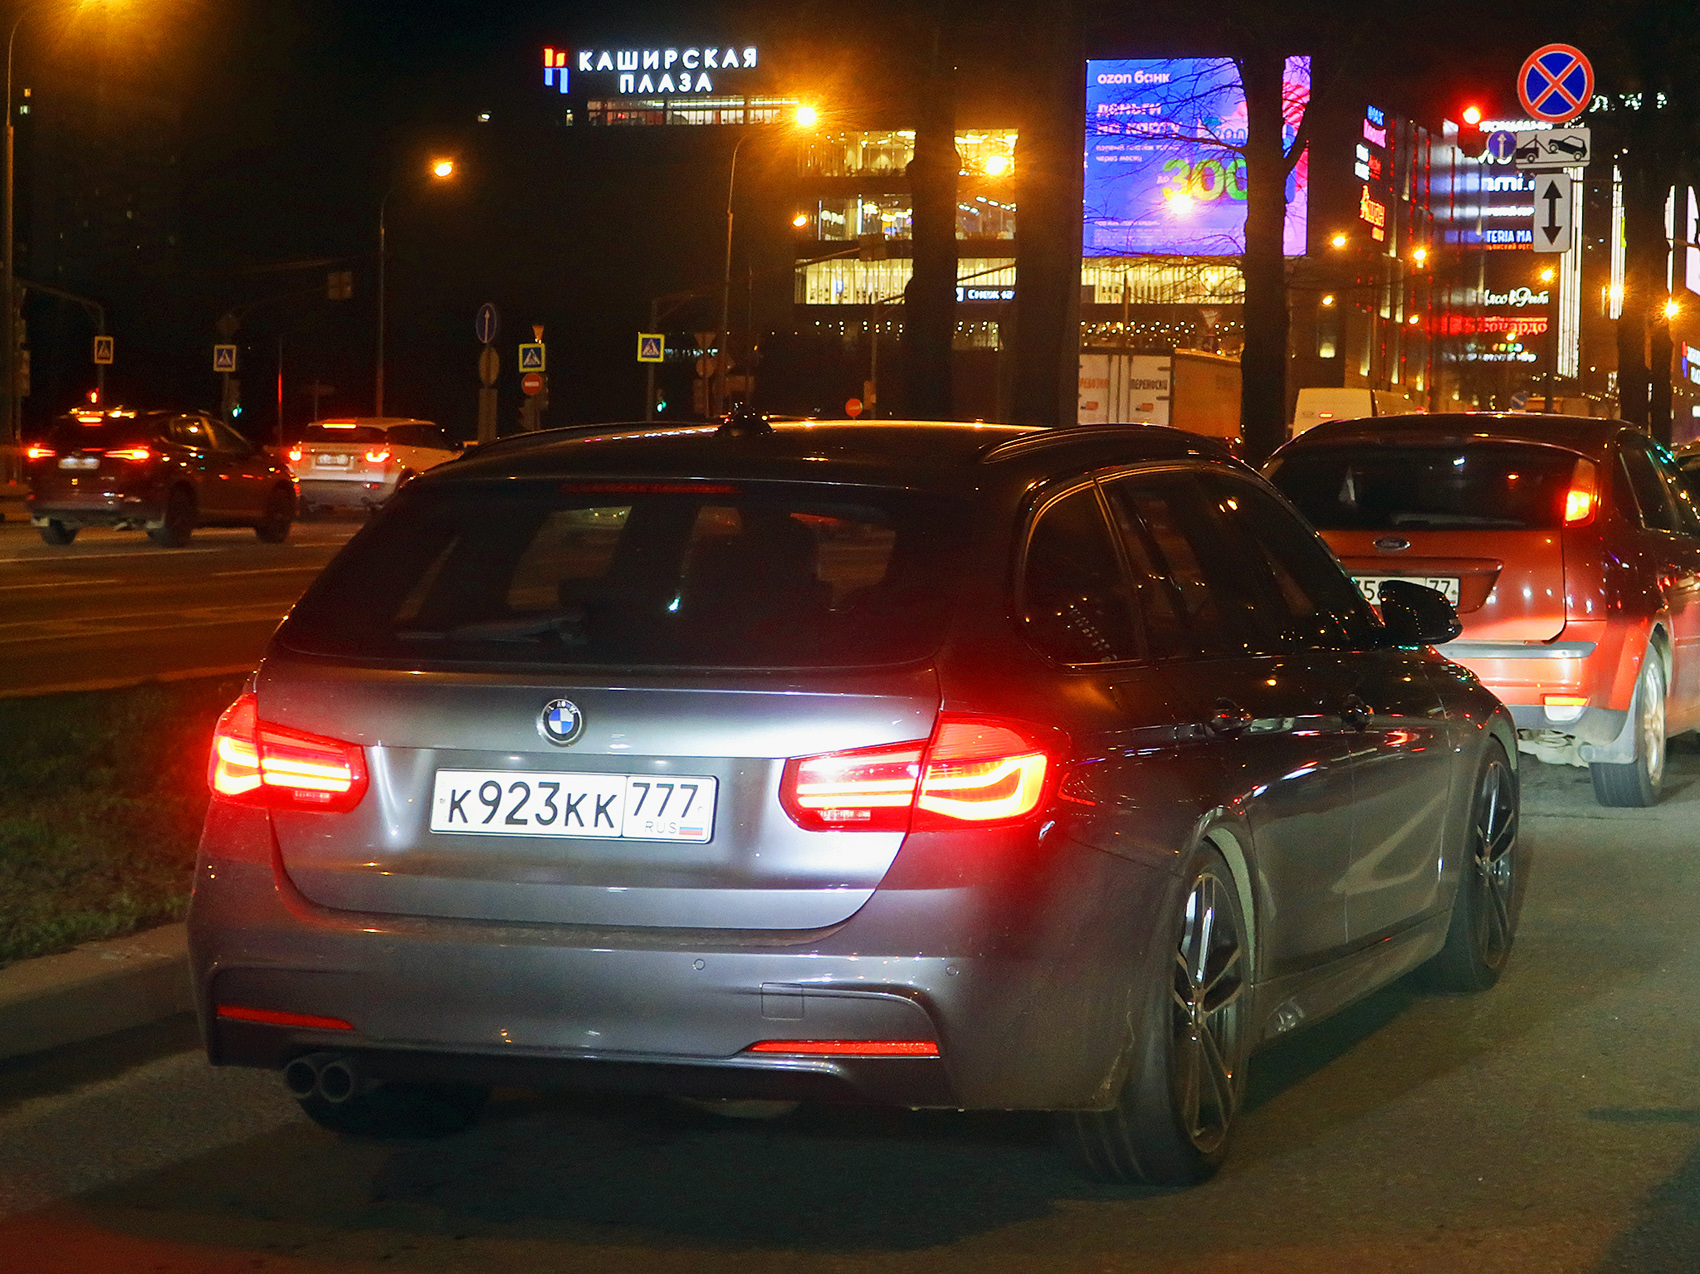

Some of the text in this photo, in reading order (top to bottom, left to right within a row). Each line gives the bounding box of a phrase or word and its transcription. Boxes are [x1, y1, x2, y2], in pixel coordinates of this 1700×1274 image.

[578, 47, 758, 72] КАШИРСКАЯ
[619, 72, 713, 94] ПЛАЗА
[1097, 70, 1171, 84] ozon банк
[631, 782, 699, 818] 777
[644, 820, 677, 834] RUS
